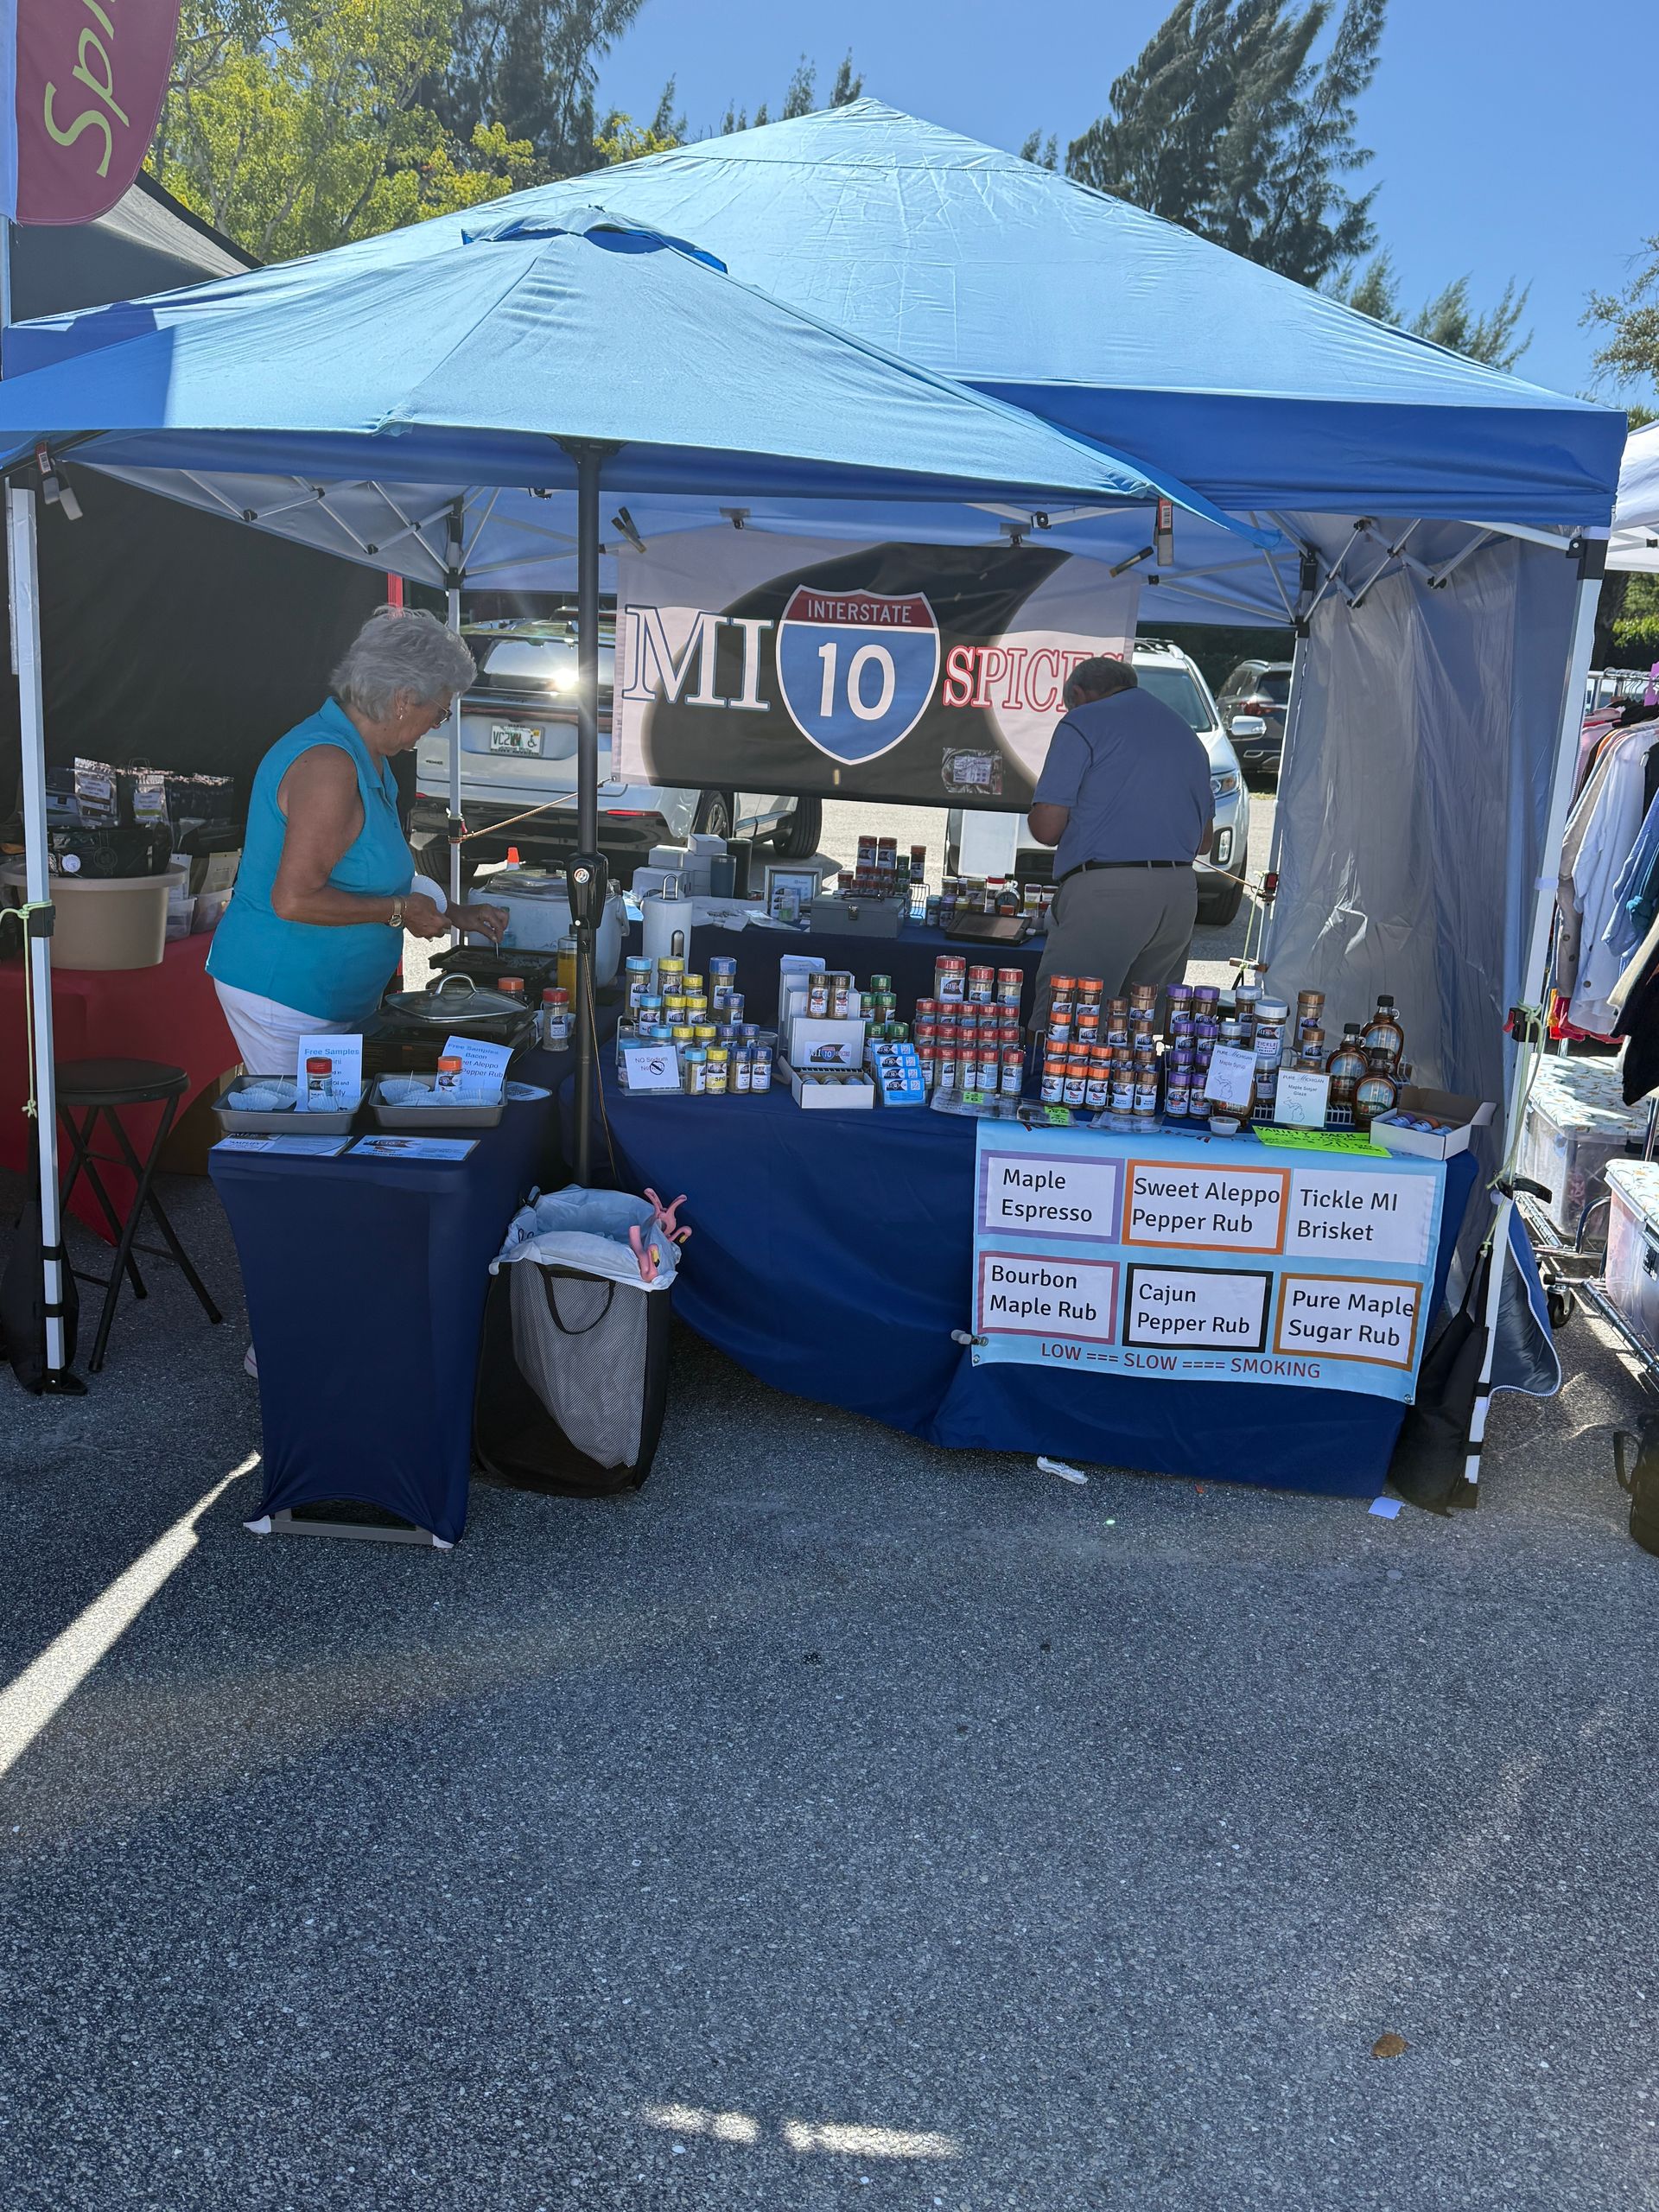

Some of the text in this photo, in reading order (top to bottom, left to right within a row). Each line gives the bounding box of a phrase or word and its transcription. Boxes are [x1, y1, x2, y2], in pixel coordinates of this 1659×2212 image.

[808, 599, 912, 625] INTERSTATE
[621, 604, 773, 710] MI
[818, 642, 896, 721] 10
[1003, 1168, 1066, 1190] Maple
[1133, 1178, 1281, 1206] Sweet Aleppo
[1300, 1188, 1398, 1211] Tickle MI
[1001, 1198, 1093, 1223] Espresso
[1131, 1209, 1253, 1234] Pepper Rub
[1297, 1220, 1374, 1242] Brisket
[992, 1265, 1077, 1289] Bourbon
[989, 1294, 1097, 1321] Maple Rub
[1139, 1284, 1196, 1306] Cajun
[1293, 1290, 1414, 1318] Pure Maple
[1137, 1312, 1249, 1335] Pepper Rub
[1288, 1319, 1401, 1346] Sugar Rub
[1041, 1343, 1081, 1361] LOW
[1124, 1352, 1178, 1370] SLOW
[1231, 1357, 1320, 1379] SMOKING
